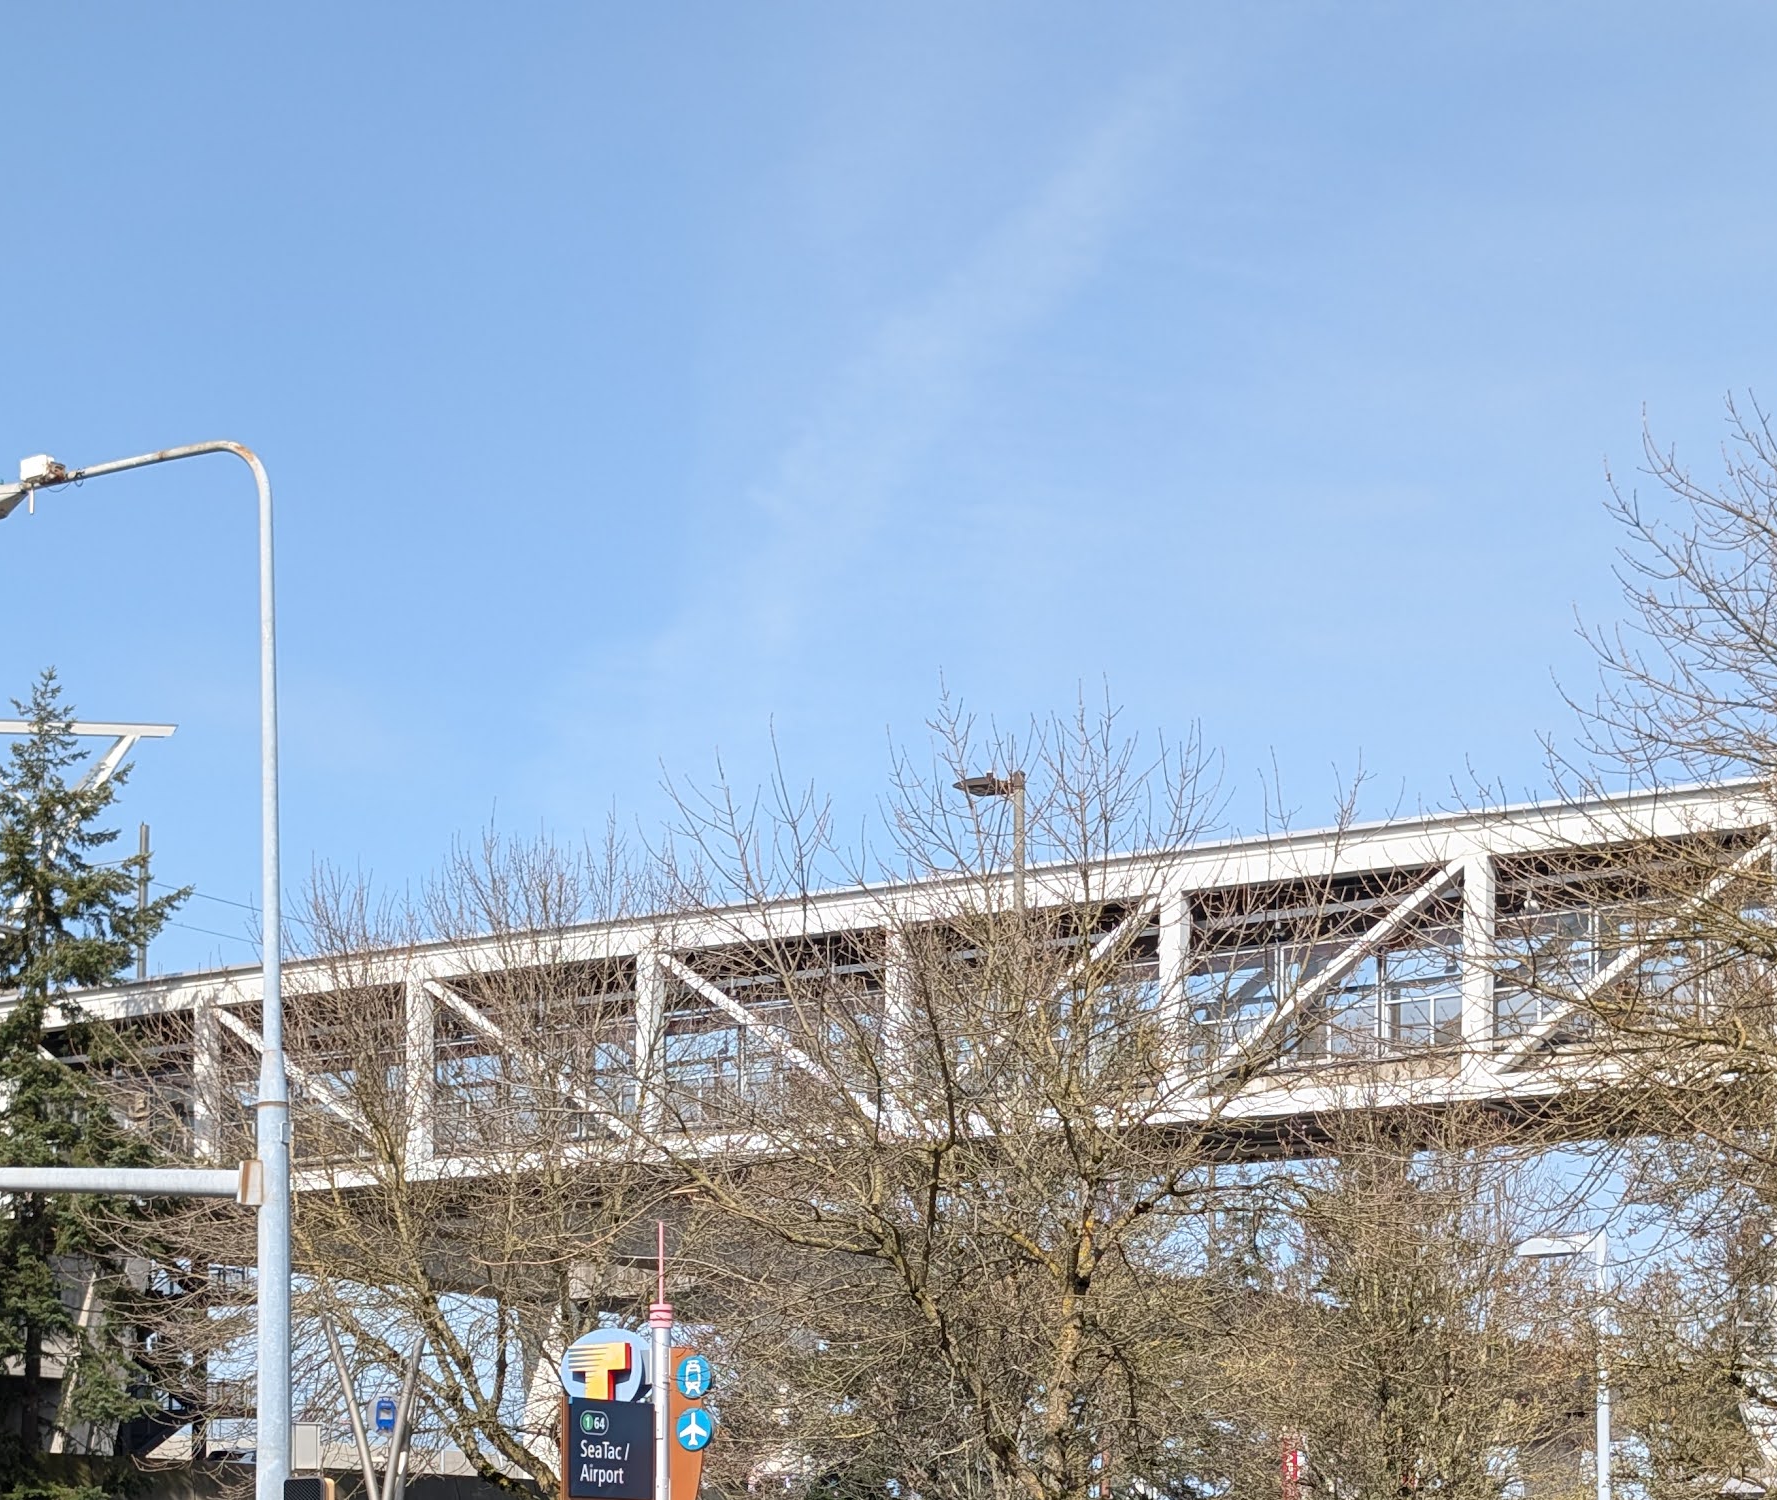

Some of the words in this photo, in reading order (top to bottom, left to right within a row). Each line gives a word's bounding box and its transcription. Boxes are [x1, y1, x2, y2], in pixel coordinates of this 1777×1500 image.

[593, 1416, 606, 1431] 64
[580, 1439, 622, 1461] SeaTac
[623, 1442, 631, 1462] /
[579, 1463, 625, 1488] Airport
